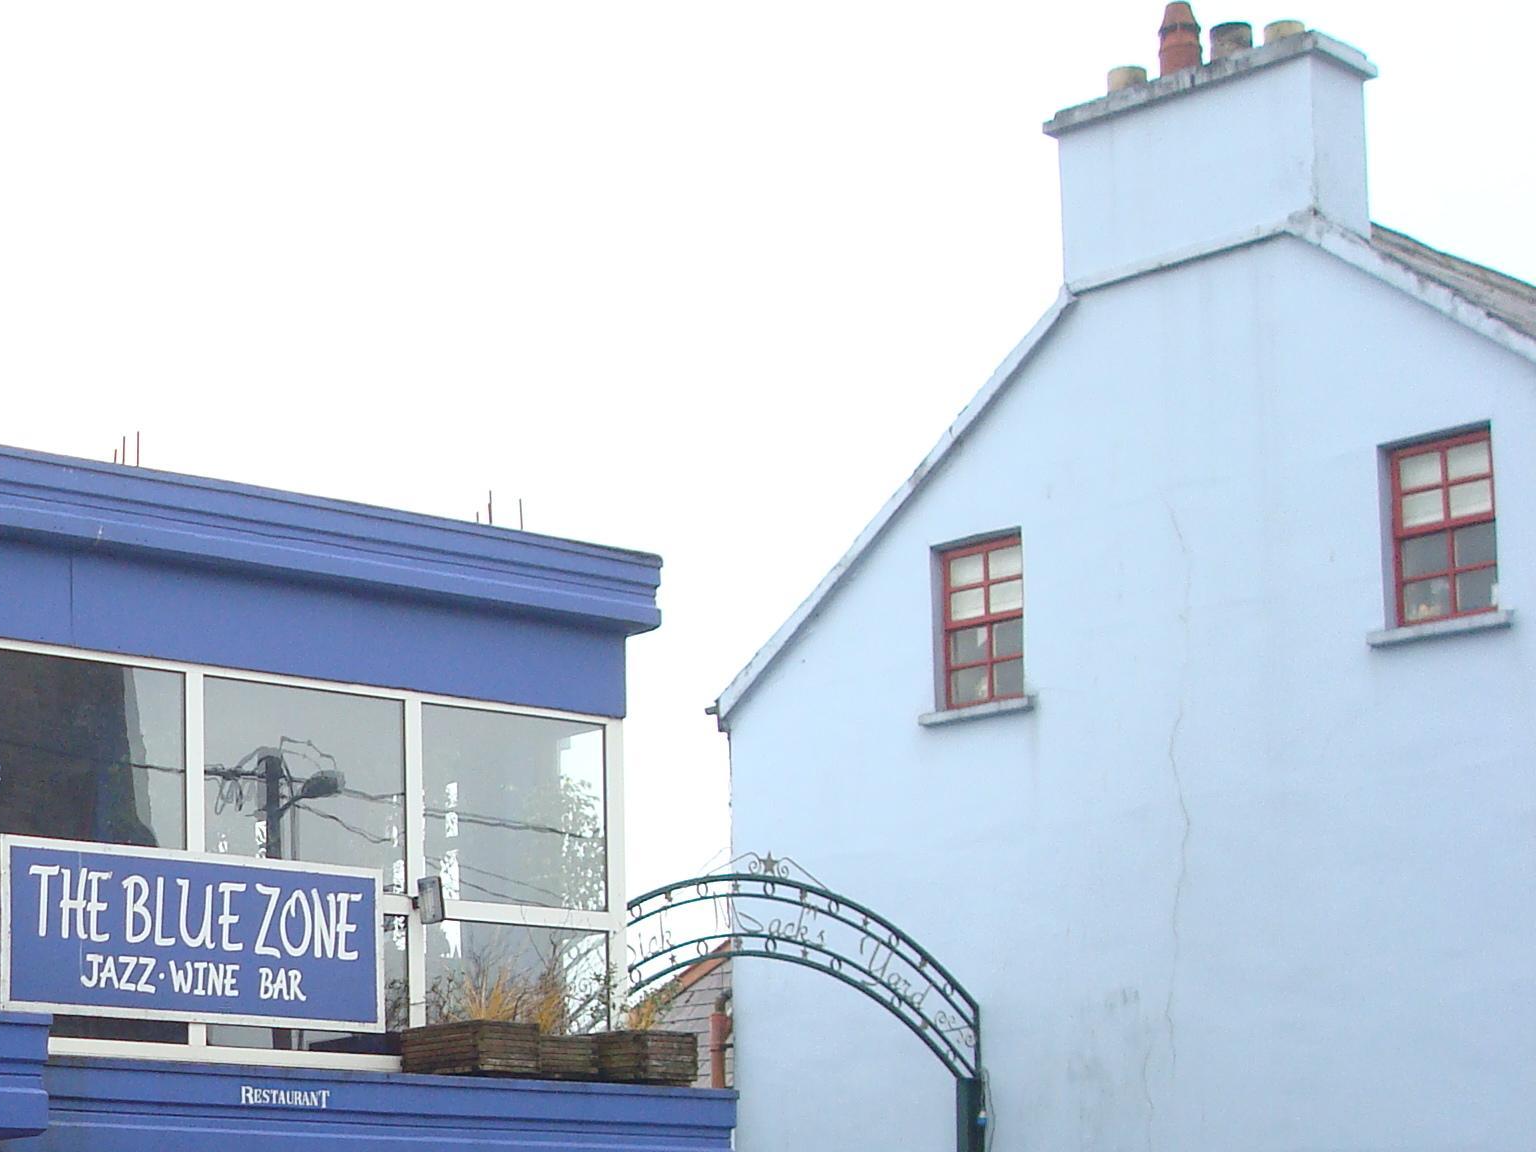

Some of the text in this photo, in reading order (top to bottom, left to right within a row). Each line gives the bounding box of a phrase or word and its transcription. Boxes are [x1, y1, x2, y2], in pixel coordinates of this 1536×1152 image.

[28, 864, 363, 961] THE BLUE ZONE
[258, 967, 307, 1001] BAR
[240, 1085, 330, 1109] RESTAURANT
